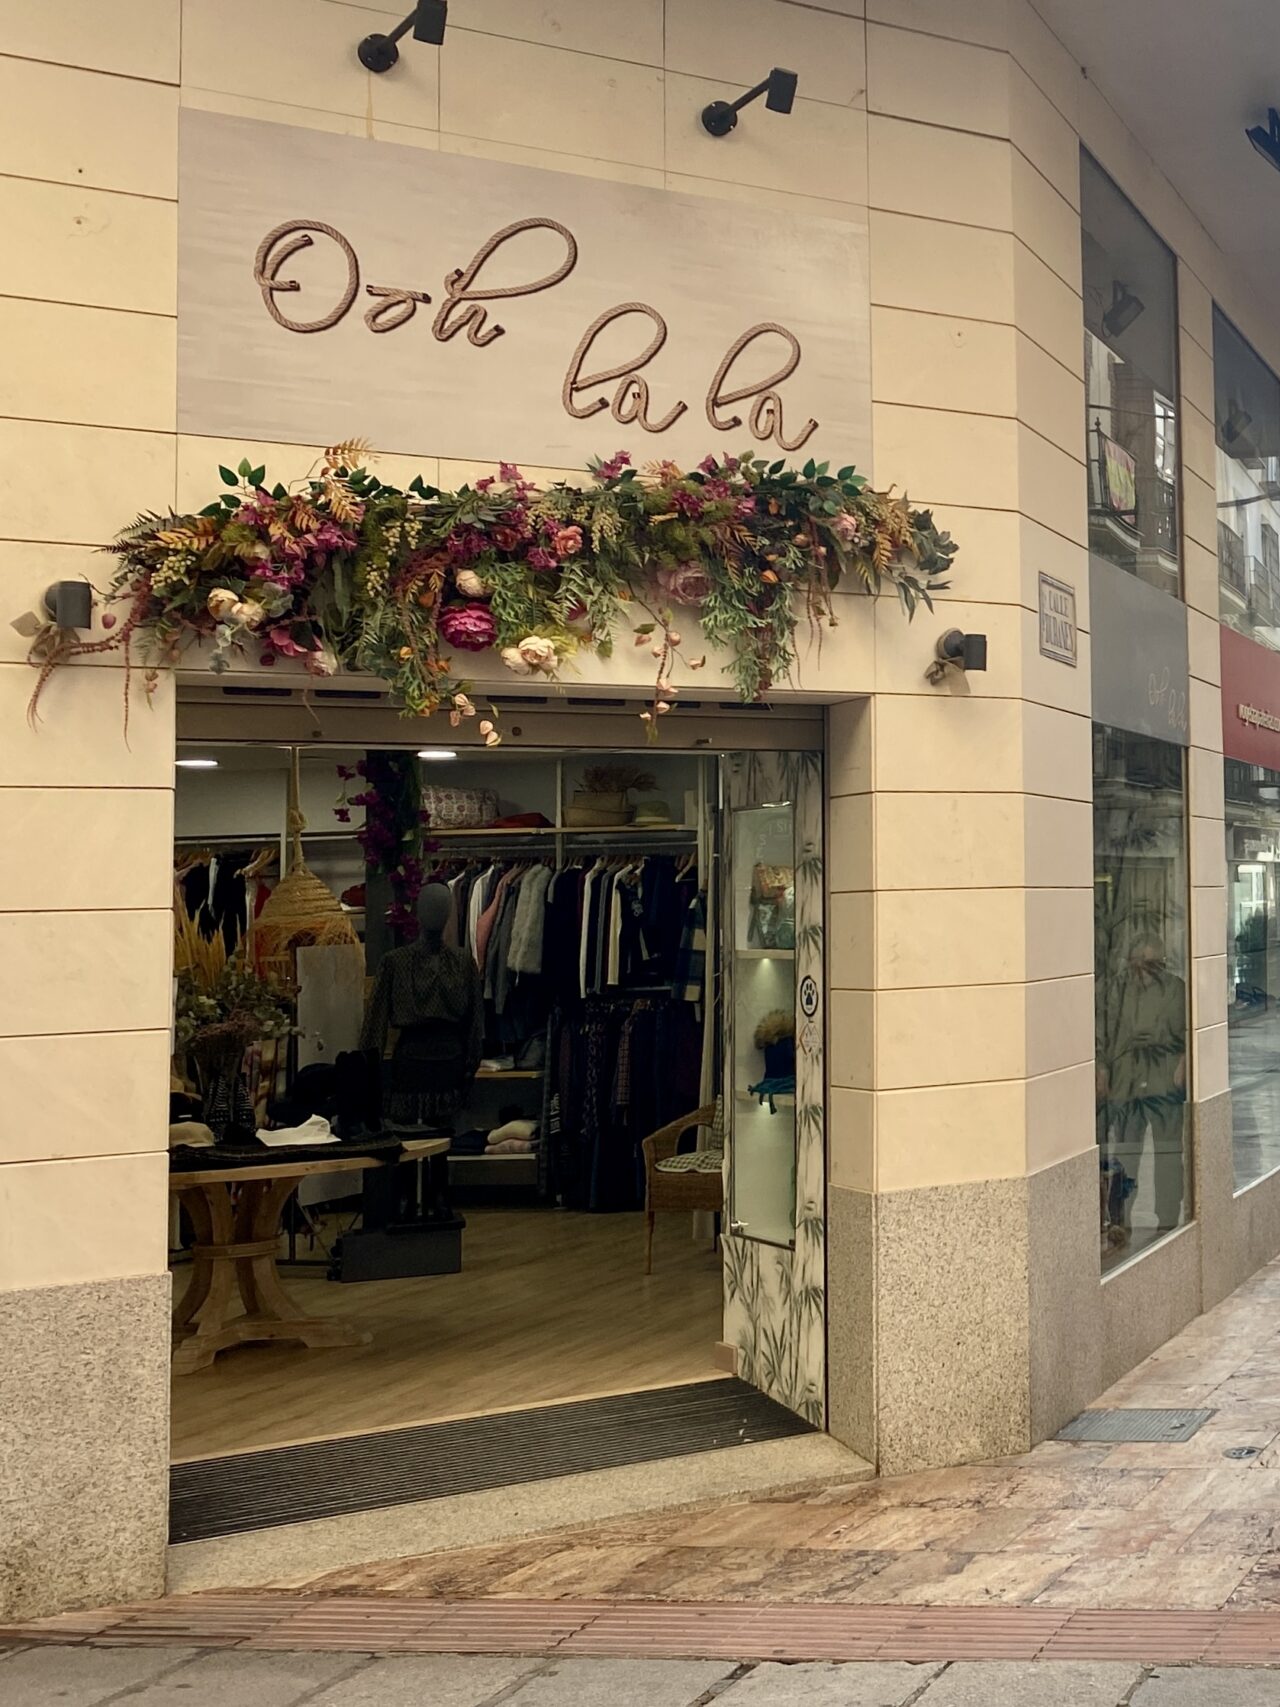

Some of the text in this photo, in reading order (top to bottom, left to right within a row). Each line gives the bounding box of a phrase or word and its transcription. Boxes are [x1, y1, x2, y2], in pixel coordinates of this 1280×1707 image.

[254, 217, 579, 347] Ooh
[562, 302, 819, 452] la la
